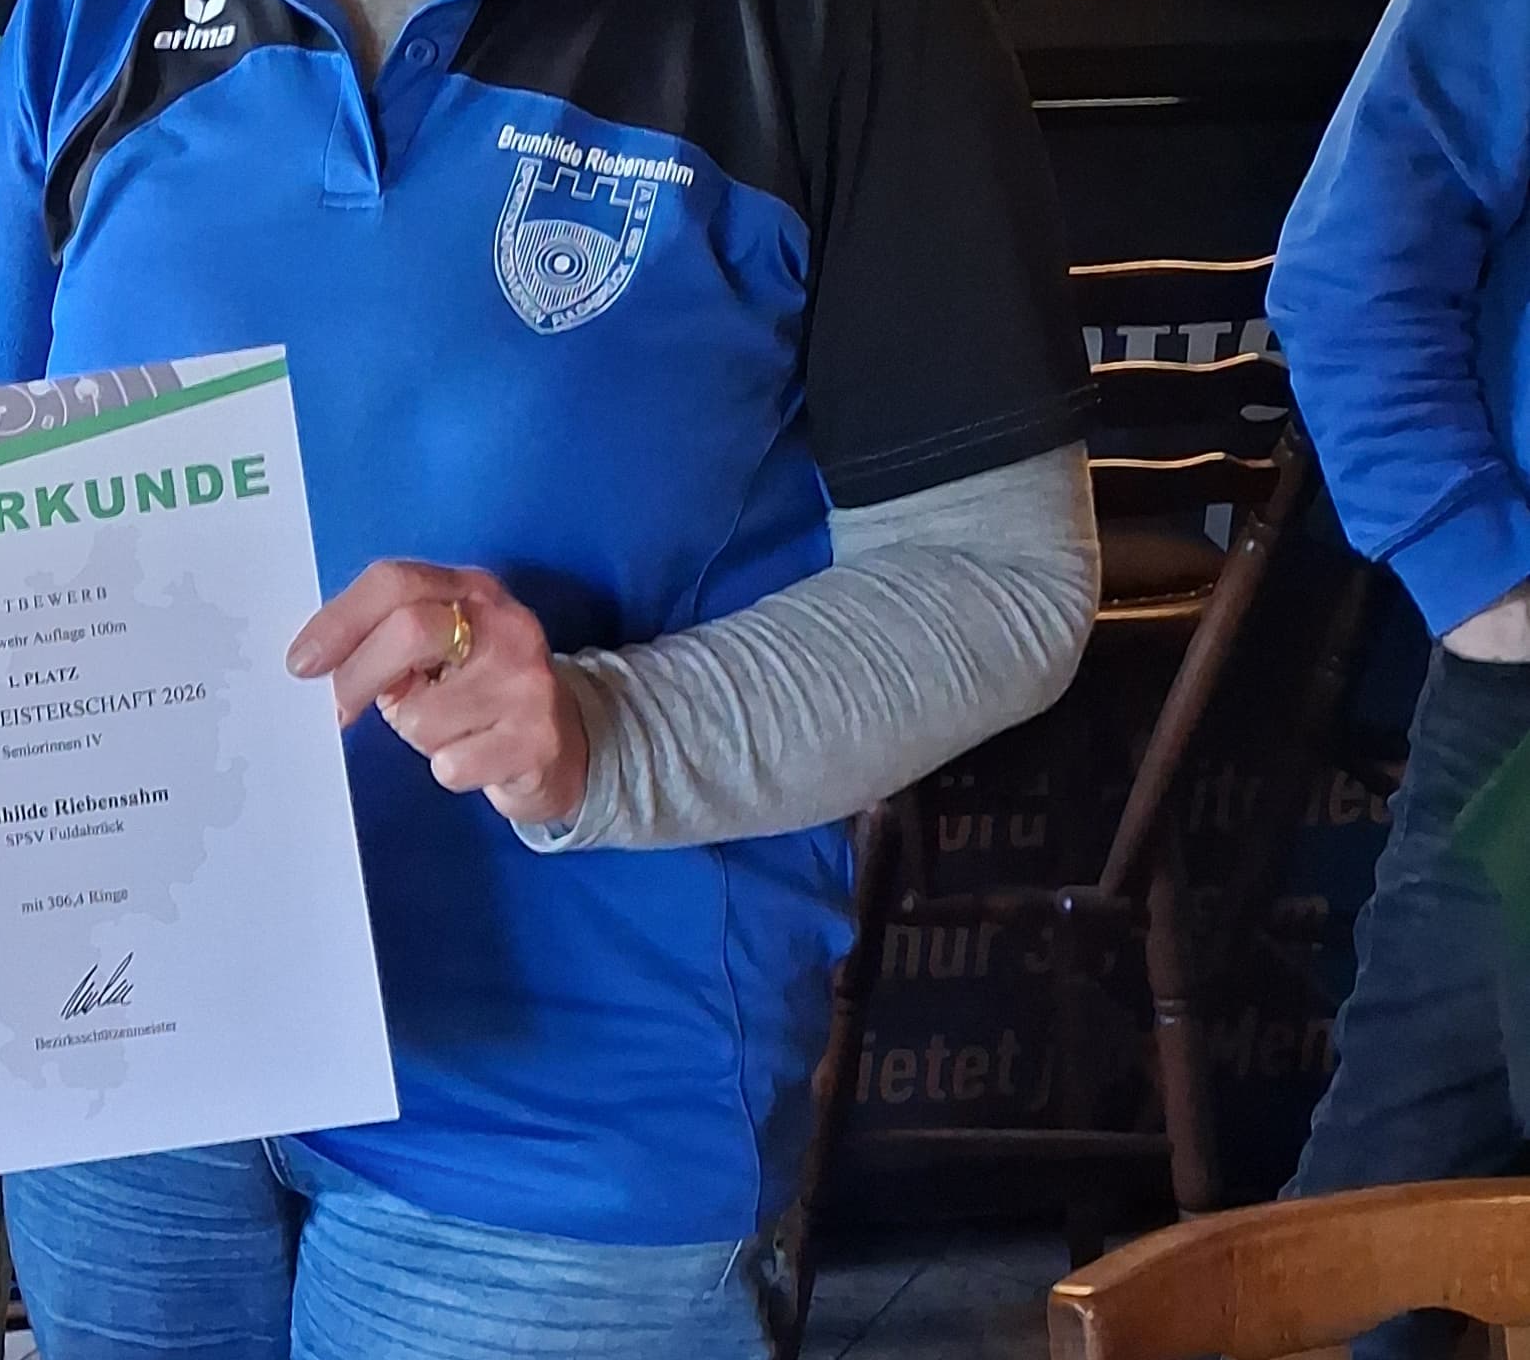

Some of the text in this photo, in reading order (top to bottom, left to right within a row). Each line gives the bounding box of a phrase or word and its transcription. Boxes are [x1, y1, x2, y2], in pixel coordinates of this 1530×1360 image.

[33, 627, 86, 646] Auflage
[90, 621, 127, 637] 100m
[24, 666, 80, 685] PLATZ
[163, 682, 207, 705] 2026
[1, 733, 103, 759] Seniorinnen IV
[54, 787, 170, 816] Riebensahm
[6, 819, 125, 847] SPSV Fuldabrück
[21, 898, 44, 914] mit
[856, 1028, 1027, 1104] ietet
